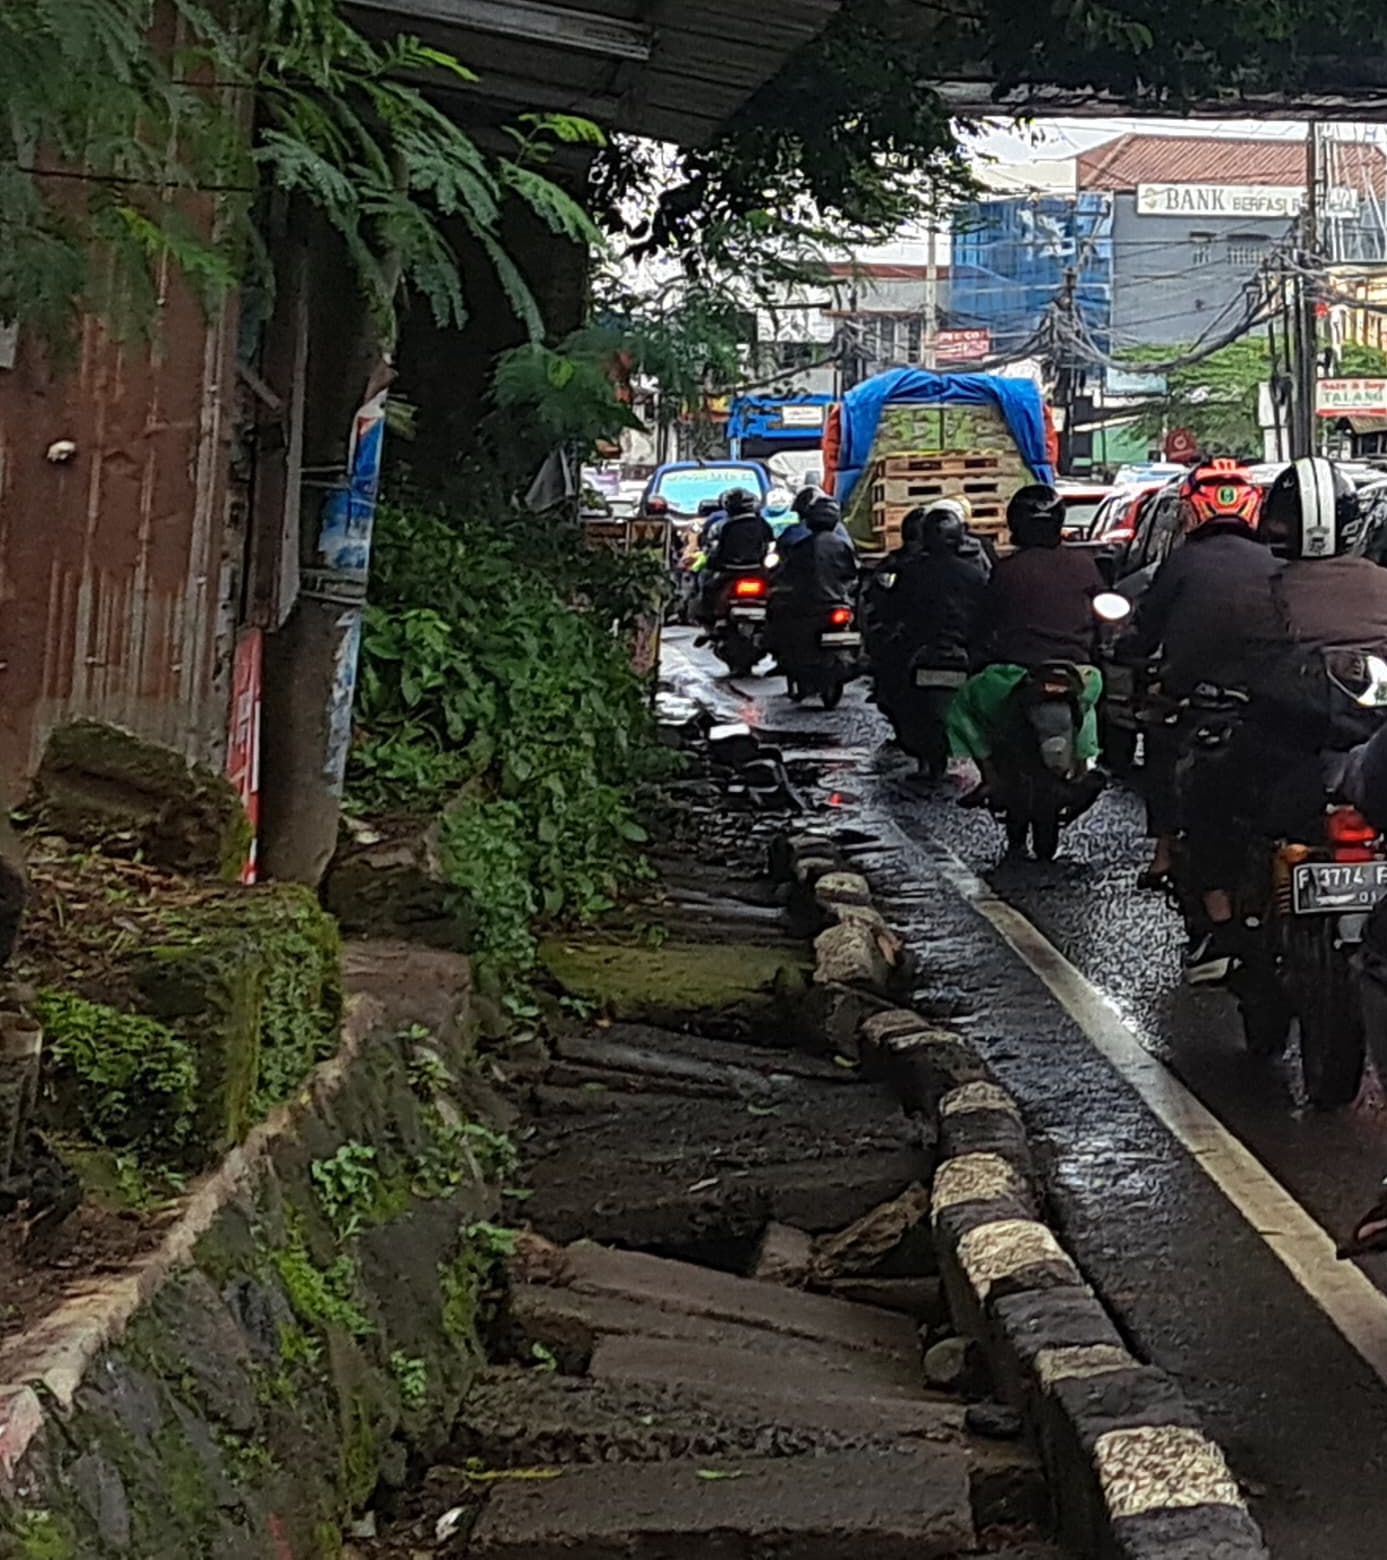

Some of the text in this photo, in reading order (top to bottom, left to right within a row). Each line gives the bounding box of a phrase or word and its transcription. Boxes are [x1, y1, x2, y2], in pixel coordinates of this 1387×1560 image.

[1165, 188, 1225, 211] BANK
[1321, 391, 1384, 403] TALANG
[1298, 869, 1310, 889] F
